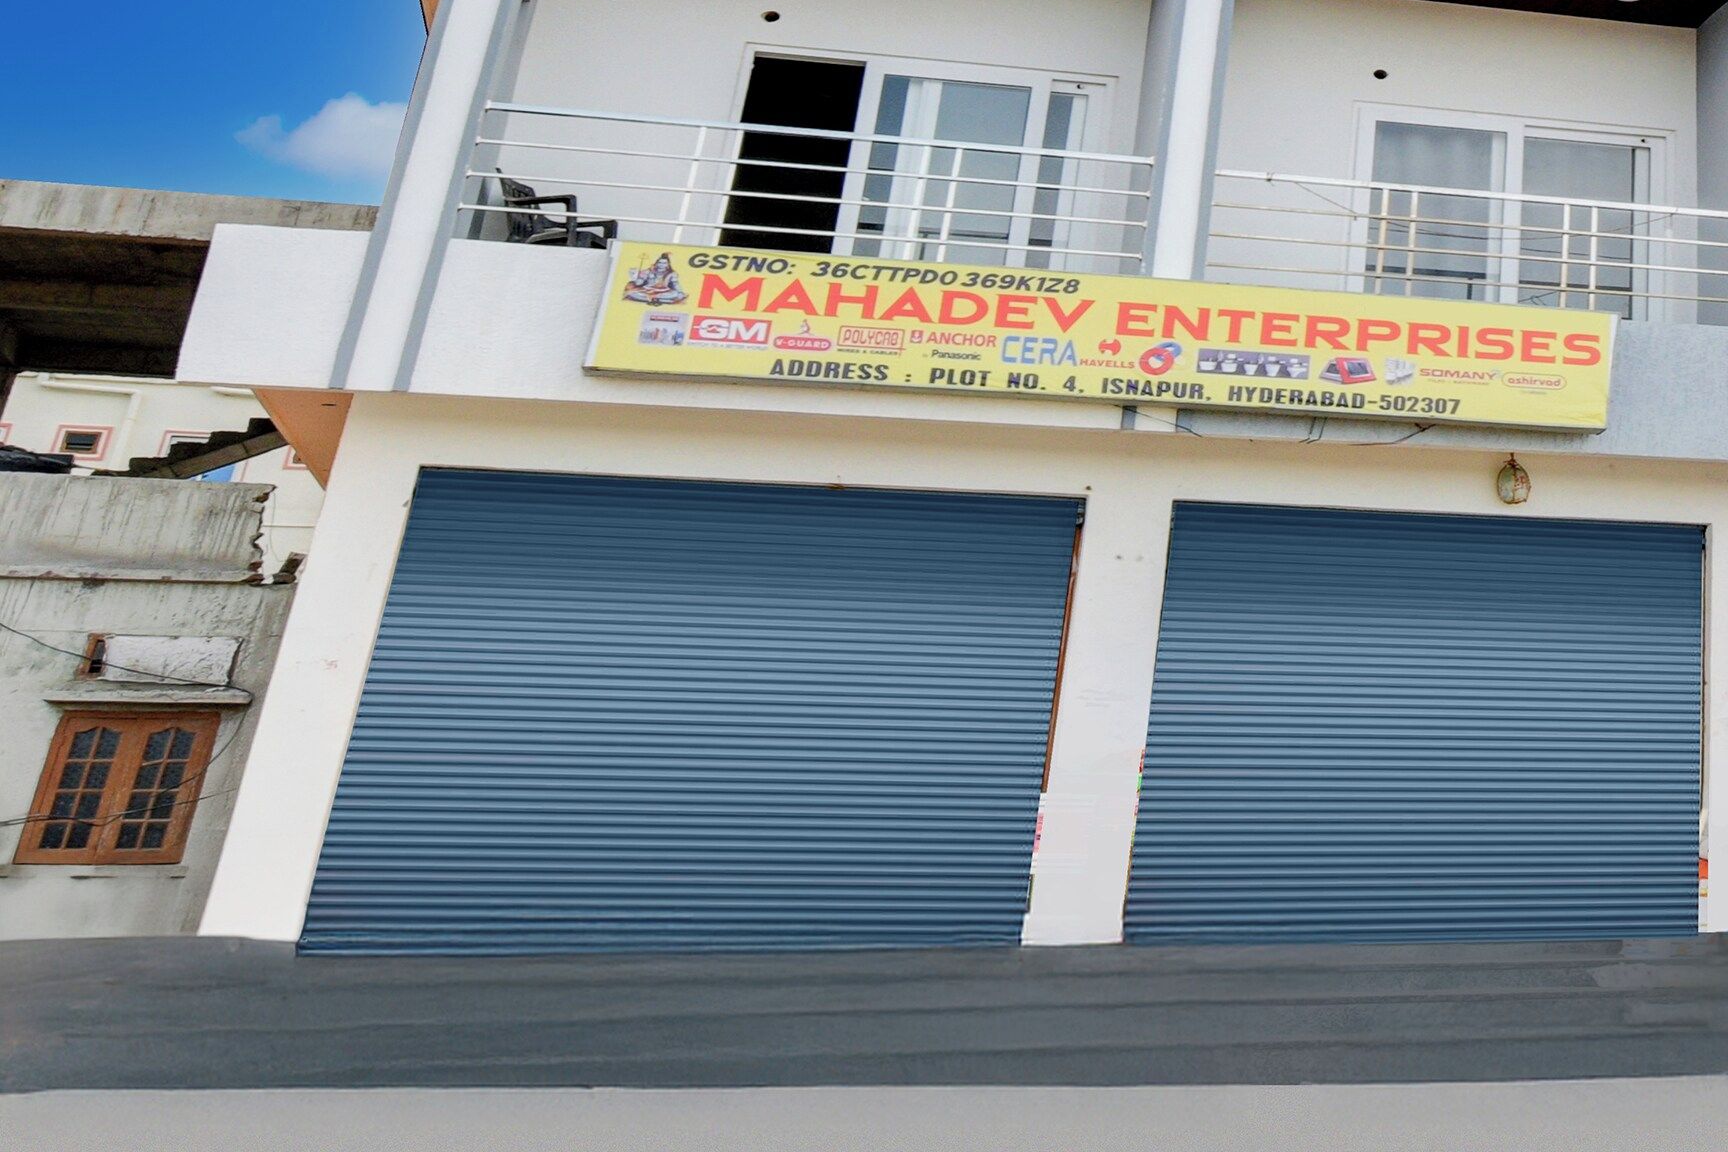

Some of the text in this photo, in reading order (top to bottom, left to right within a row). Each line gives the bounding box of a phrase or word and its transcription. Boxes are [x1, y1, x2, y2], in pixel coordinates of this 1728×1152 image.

[697, 273, 1603, 367] MAHADEV ENTERPRISES
[699, 319, 769, 342] GM
[843, 328, 899, 346] POLYCAB
[775, 337, 829, 349] V-GUARD
[926, 331, 997, 348] ANCHOR
[931, 349, 982, 361] Panasonic
[1001, 335, 1078, 367] CERA
[1079, 358, 1136, 369] HAVELLS
[1419, 367, 1498, 381] SOMANY
[1507, 375, 1562, 387] ashirvad
[769, 358, 890, 381] ADDRESS
[929, 367, 991, 387] PLOT
[1007, 372, 1047, 391] NO.
[1101, 377, 1212, 401] ISNAPUR,
[1228, 384, 1461, 415] HYDERABAD-502307
